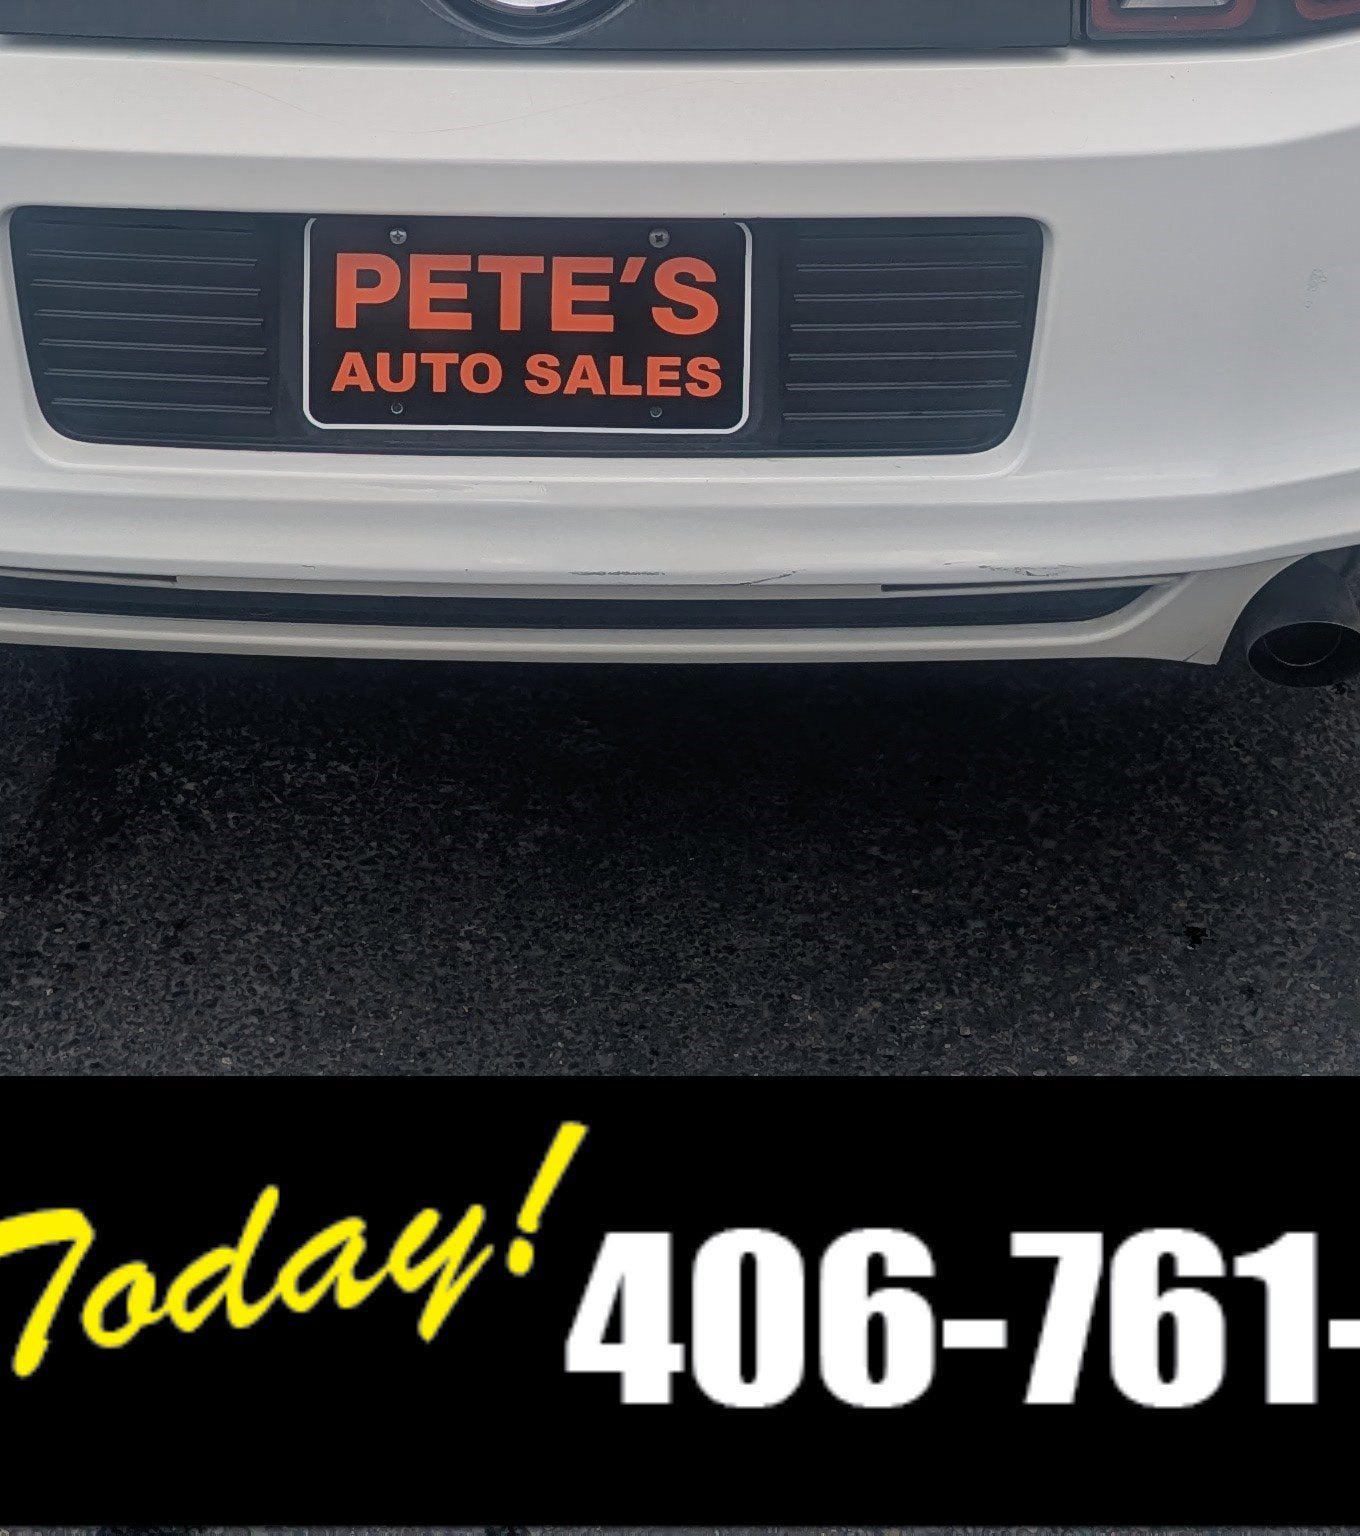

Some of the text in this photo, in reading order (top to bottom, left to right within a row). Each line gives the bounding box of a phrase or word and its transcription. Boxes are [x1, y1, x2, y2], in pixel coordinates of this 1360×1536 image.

[335, 252, 719, 336] PETE'S
[331, 351, 723, 398] AUTO SALES
